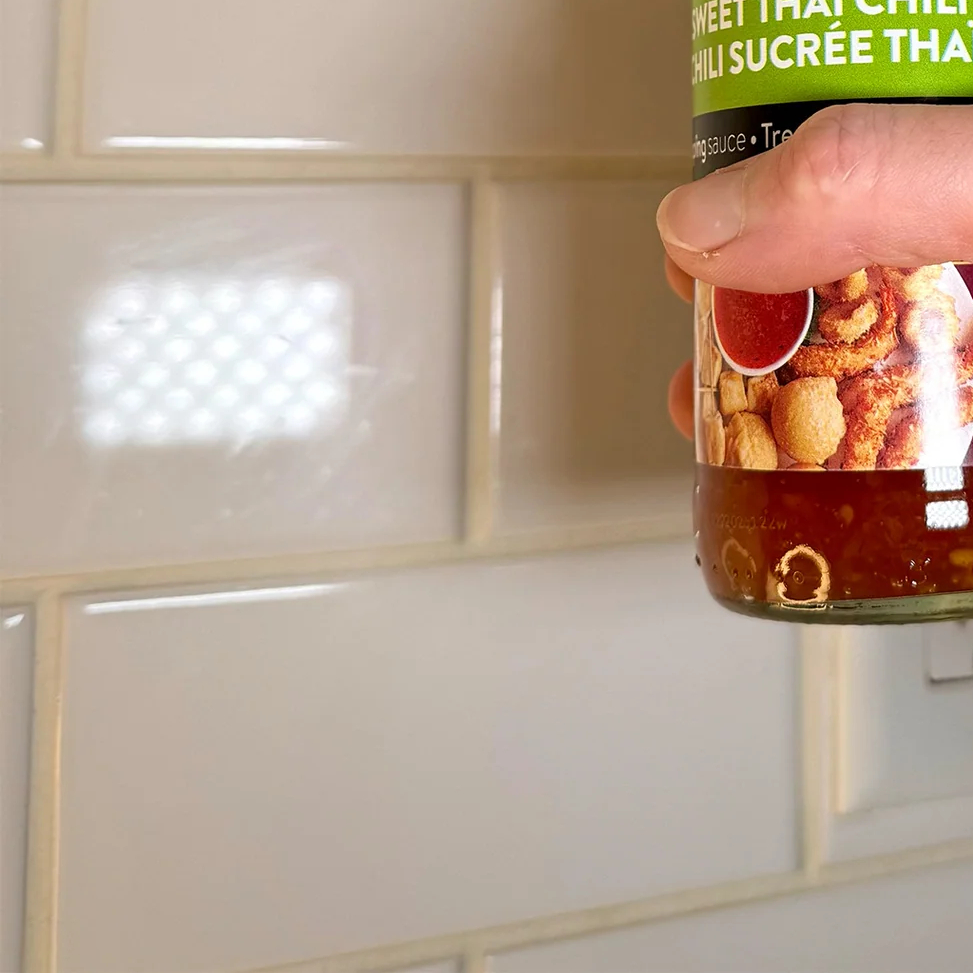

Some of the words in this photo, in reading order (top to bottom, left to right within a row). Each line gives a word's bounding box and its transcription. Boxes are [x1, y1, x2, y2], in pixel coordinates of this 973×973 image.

[729, 21, 873, 75] SUCRÉE
[692, 134, 707, 163] ing
[707, 133, 747, 155] sauce
[761, 122, 794, 148] Tre
